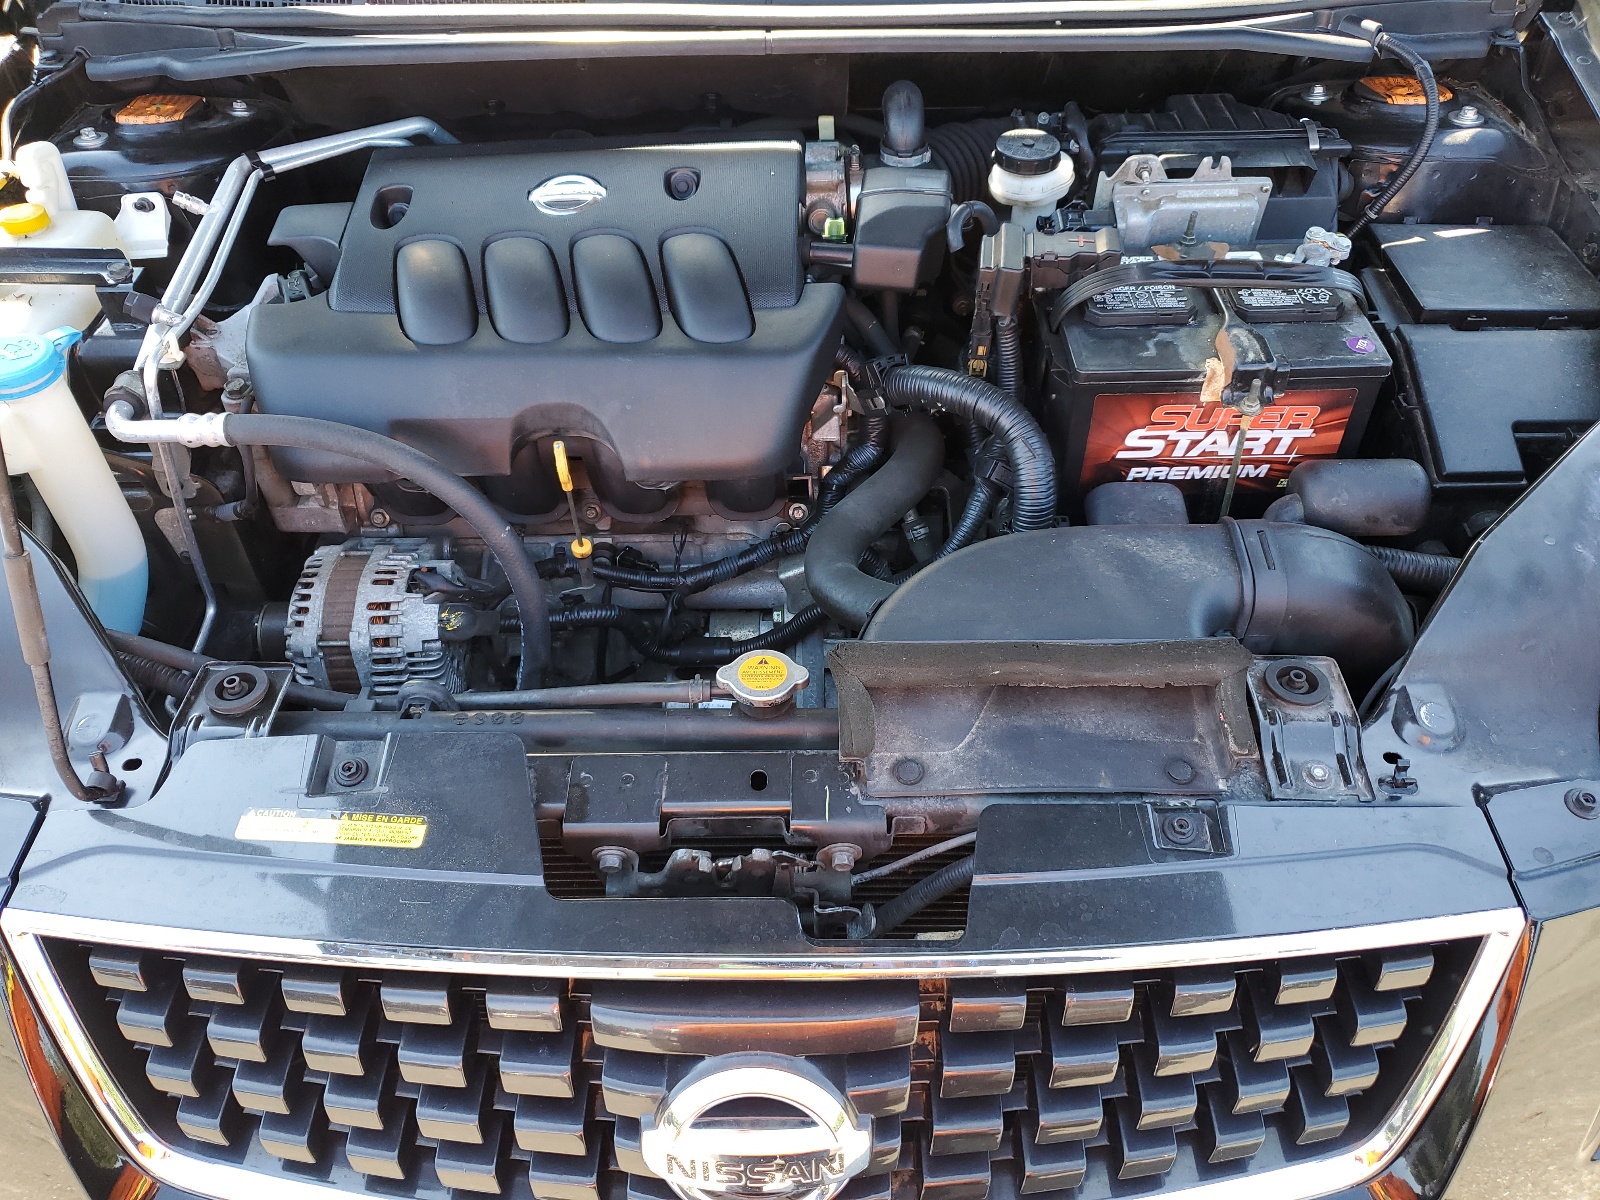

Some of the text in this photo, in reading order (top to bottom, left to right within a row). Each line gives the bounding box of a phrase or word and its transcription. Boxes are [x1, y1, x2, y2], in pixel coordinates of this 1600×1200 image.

[1146, 404, 1321, 431] SUPER
[1115, 428, 1314, 459] START
[1126, 464, 1271, 481] PREMIUM
[257, 809, 297, 818] CAUTION
[352, 813, 424, 825] MISE EN GARDE
[666, 1152, 845, 1187] NISSAN
